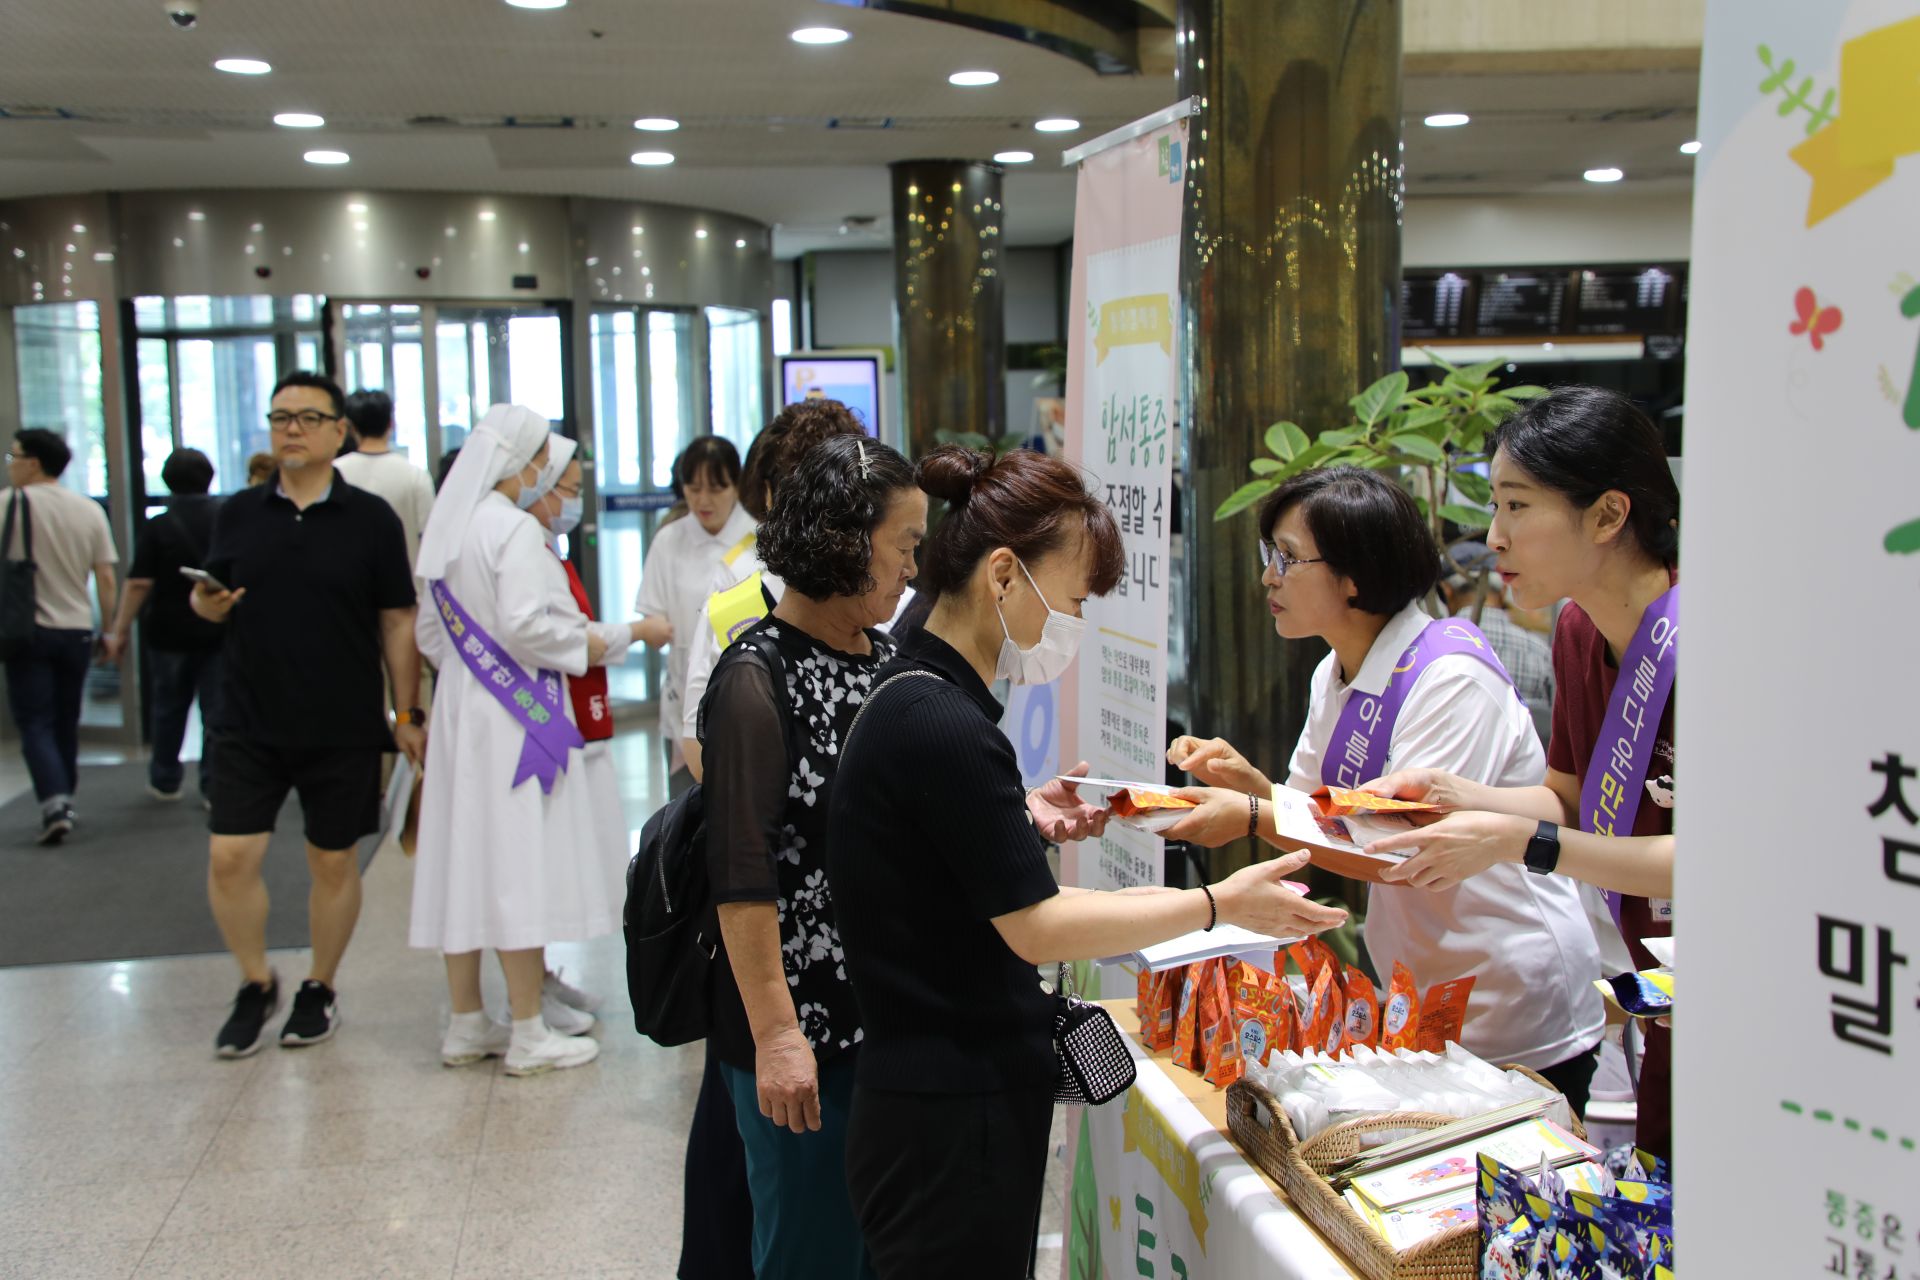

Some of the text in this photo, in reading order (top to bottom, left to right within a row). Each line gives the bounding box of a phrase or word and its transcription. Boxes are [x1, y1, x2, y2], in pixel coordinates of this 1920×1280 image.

[1101, 392, 1167, 469] 암성통증
[1106, 484, 1147, 535] 조절할
[1611, 616, 1678, 782] 아름다운
[1825, 1188, 1905, 1256] 통증은
